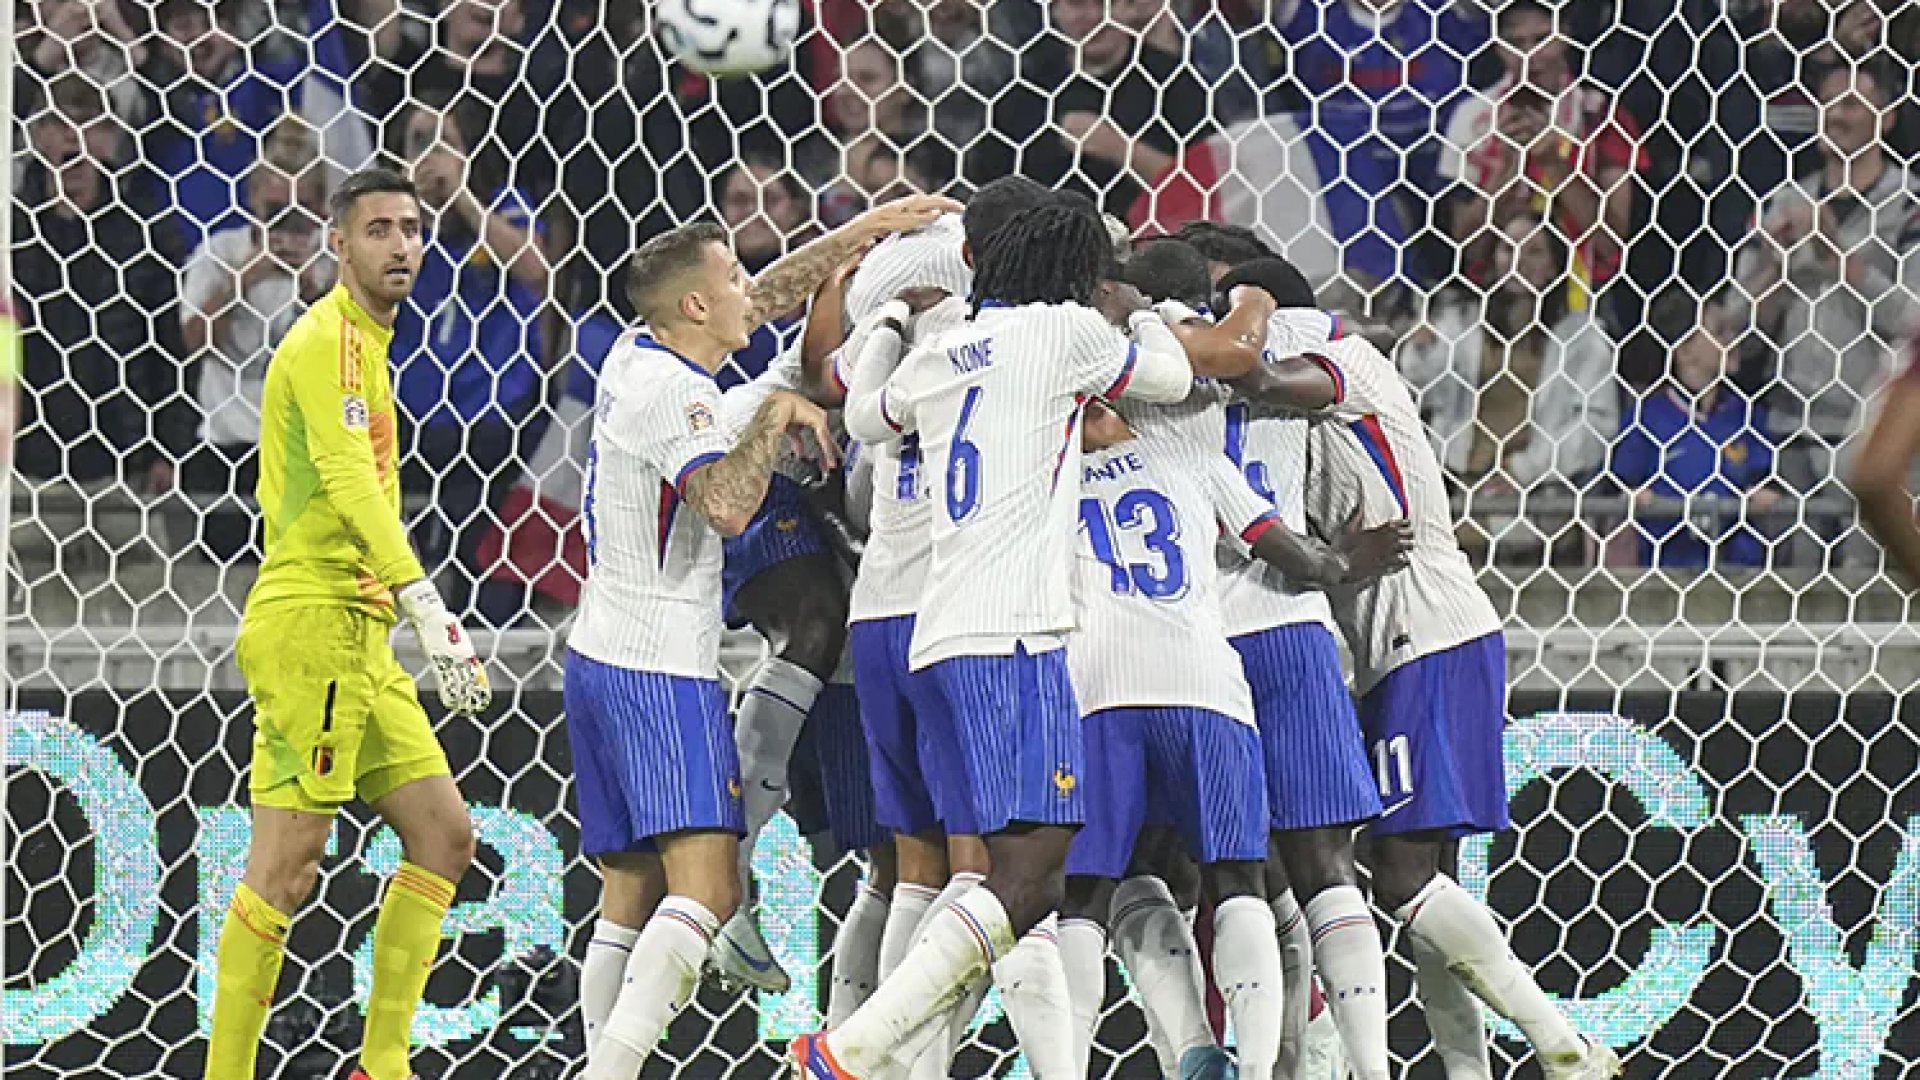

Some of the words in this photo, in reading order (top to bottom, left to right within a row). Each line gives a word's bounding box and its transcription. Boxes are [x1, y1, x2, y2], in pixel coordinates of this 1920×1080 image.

[946, 386, 983, 527] 6
[1080, 452, 1143, 485] ANTE
[1077, 487, 1191, 601] 13
[1371, 734, 1413, 796] 11
